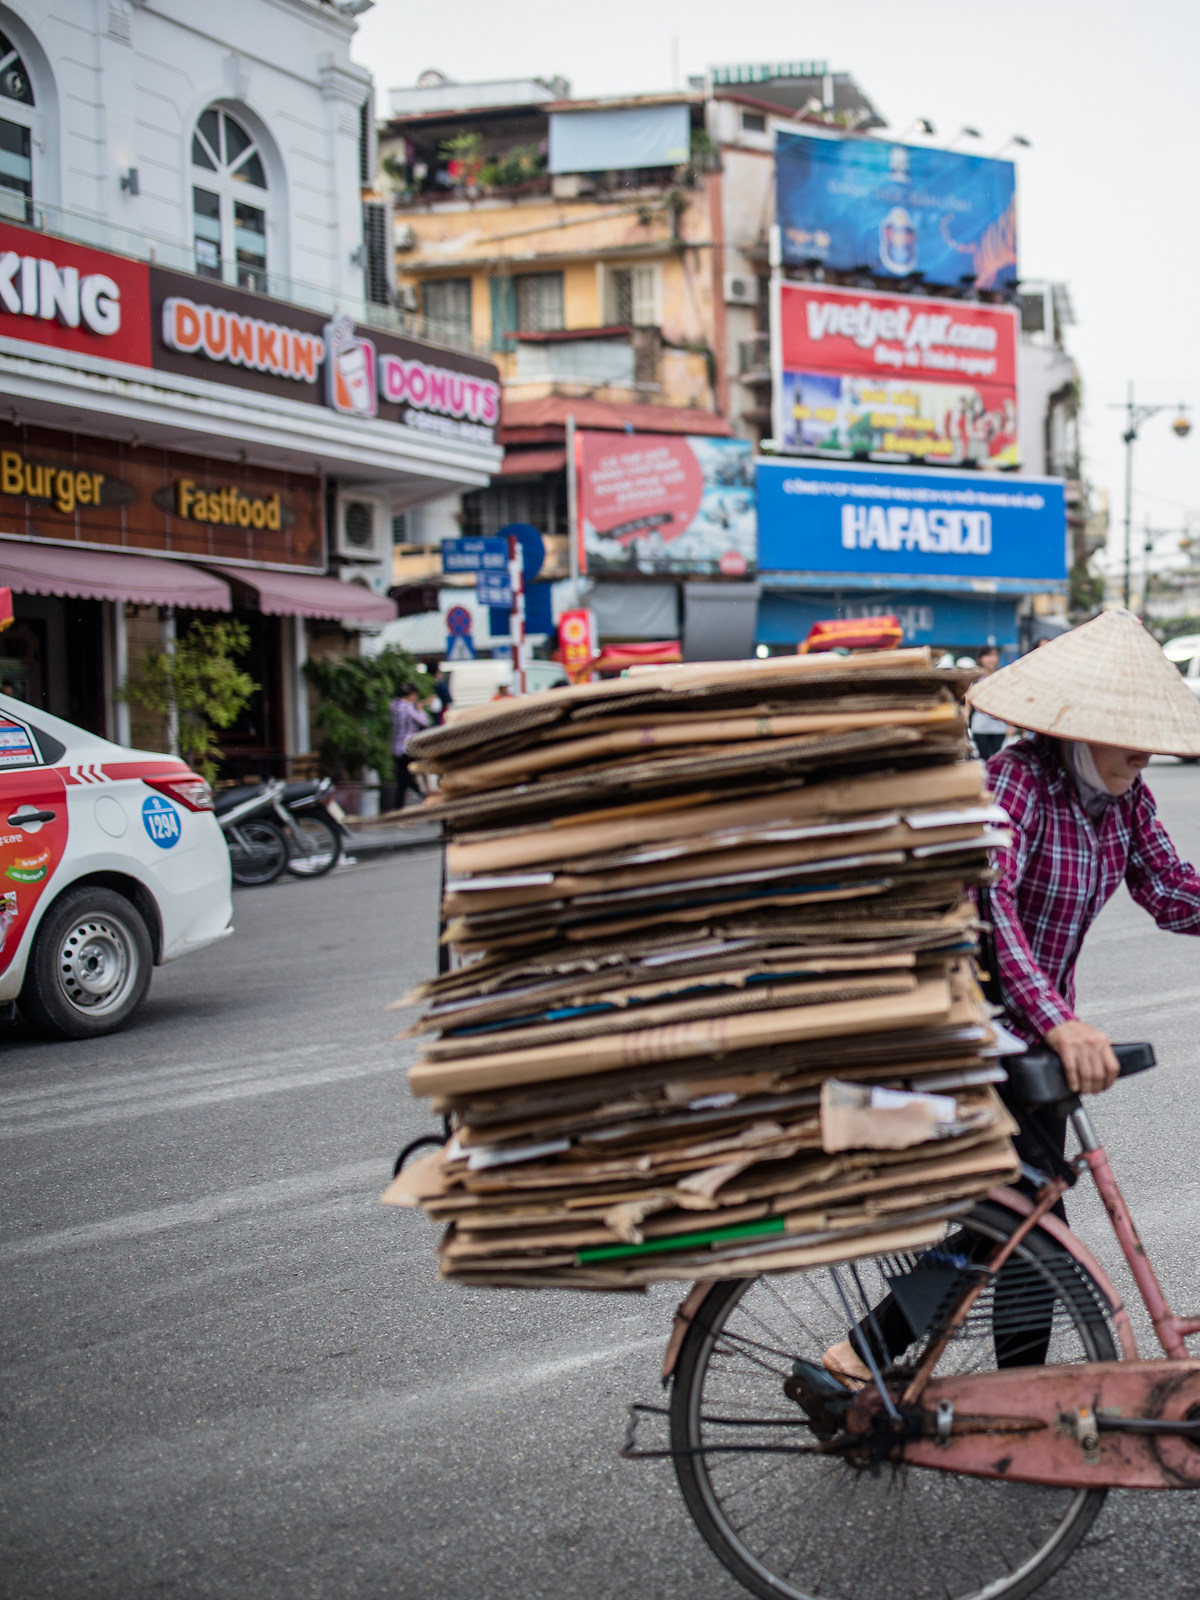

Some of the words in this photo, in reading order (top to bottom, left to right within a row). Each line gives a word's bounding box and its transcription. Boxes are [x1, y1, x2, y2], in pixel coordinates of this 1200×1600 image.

[0, 250, 121, 335] KING
[172, 300, 325, 381] DUNKIN'
[386, 358, 500, 426] DONUTS
[2, 452, 104, 513] Burger
[178, 479, 281, 531] Fastfood
[841, 504, 992, 556] HAFASCO
[148, 812, 179, 840] 1294
